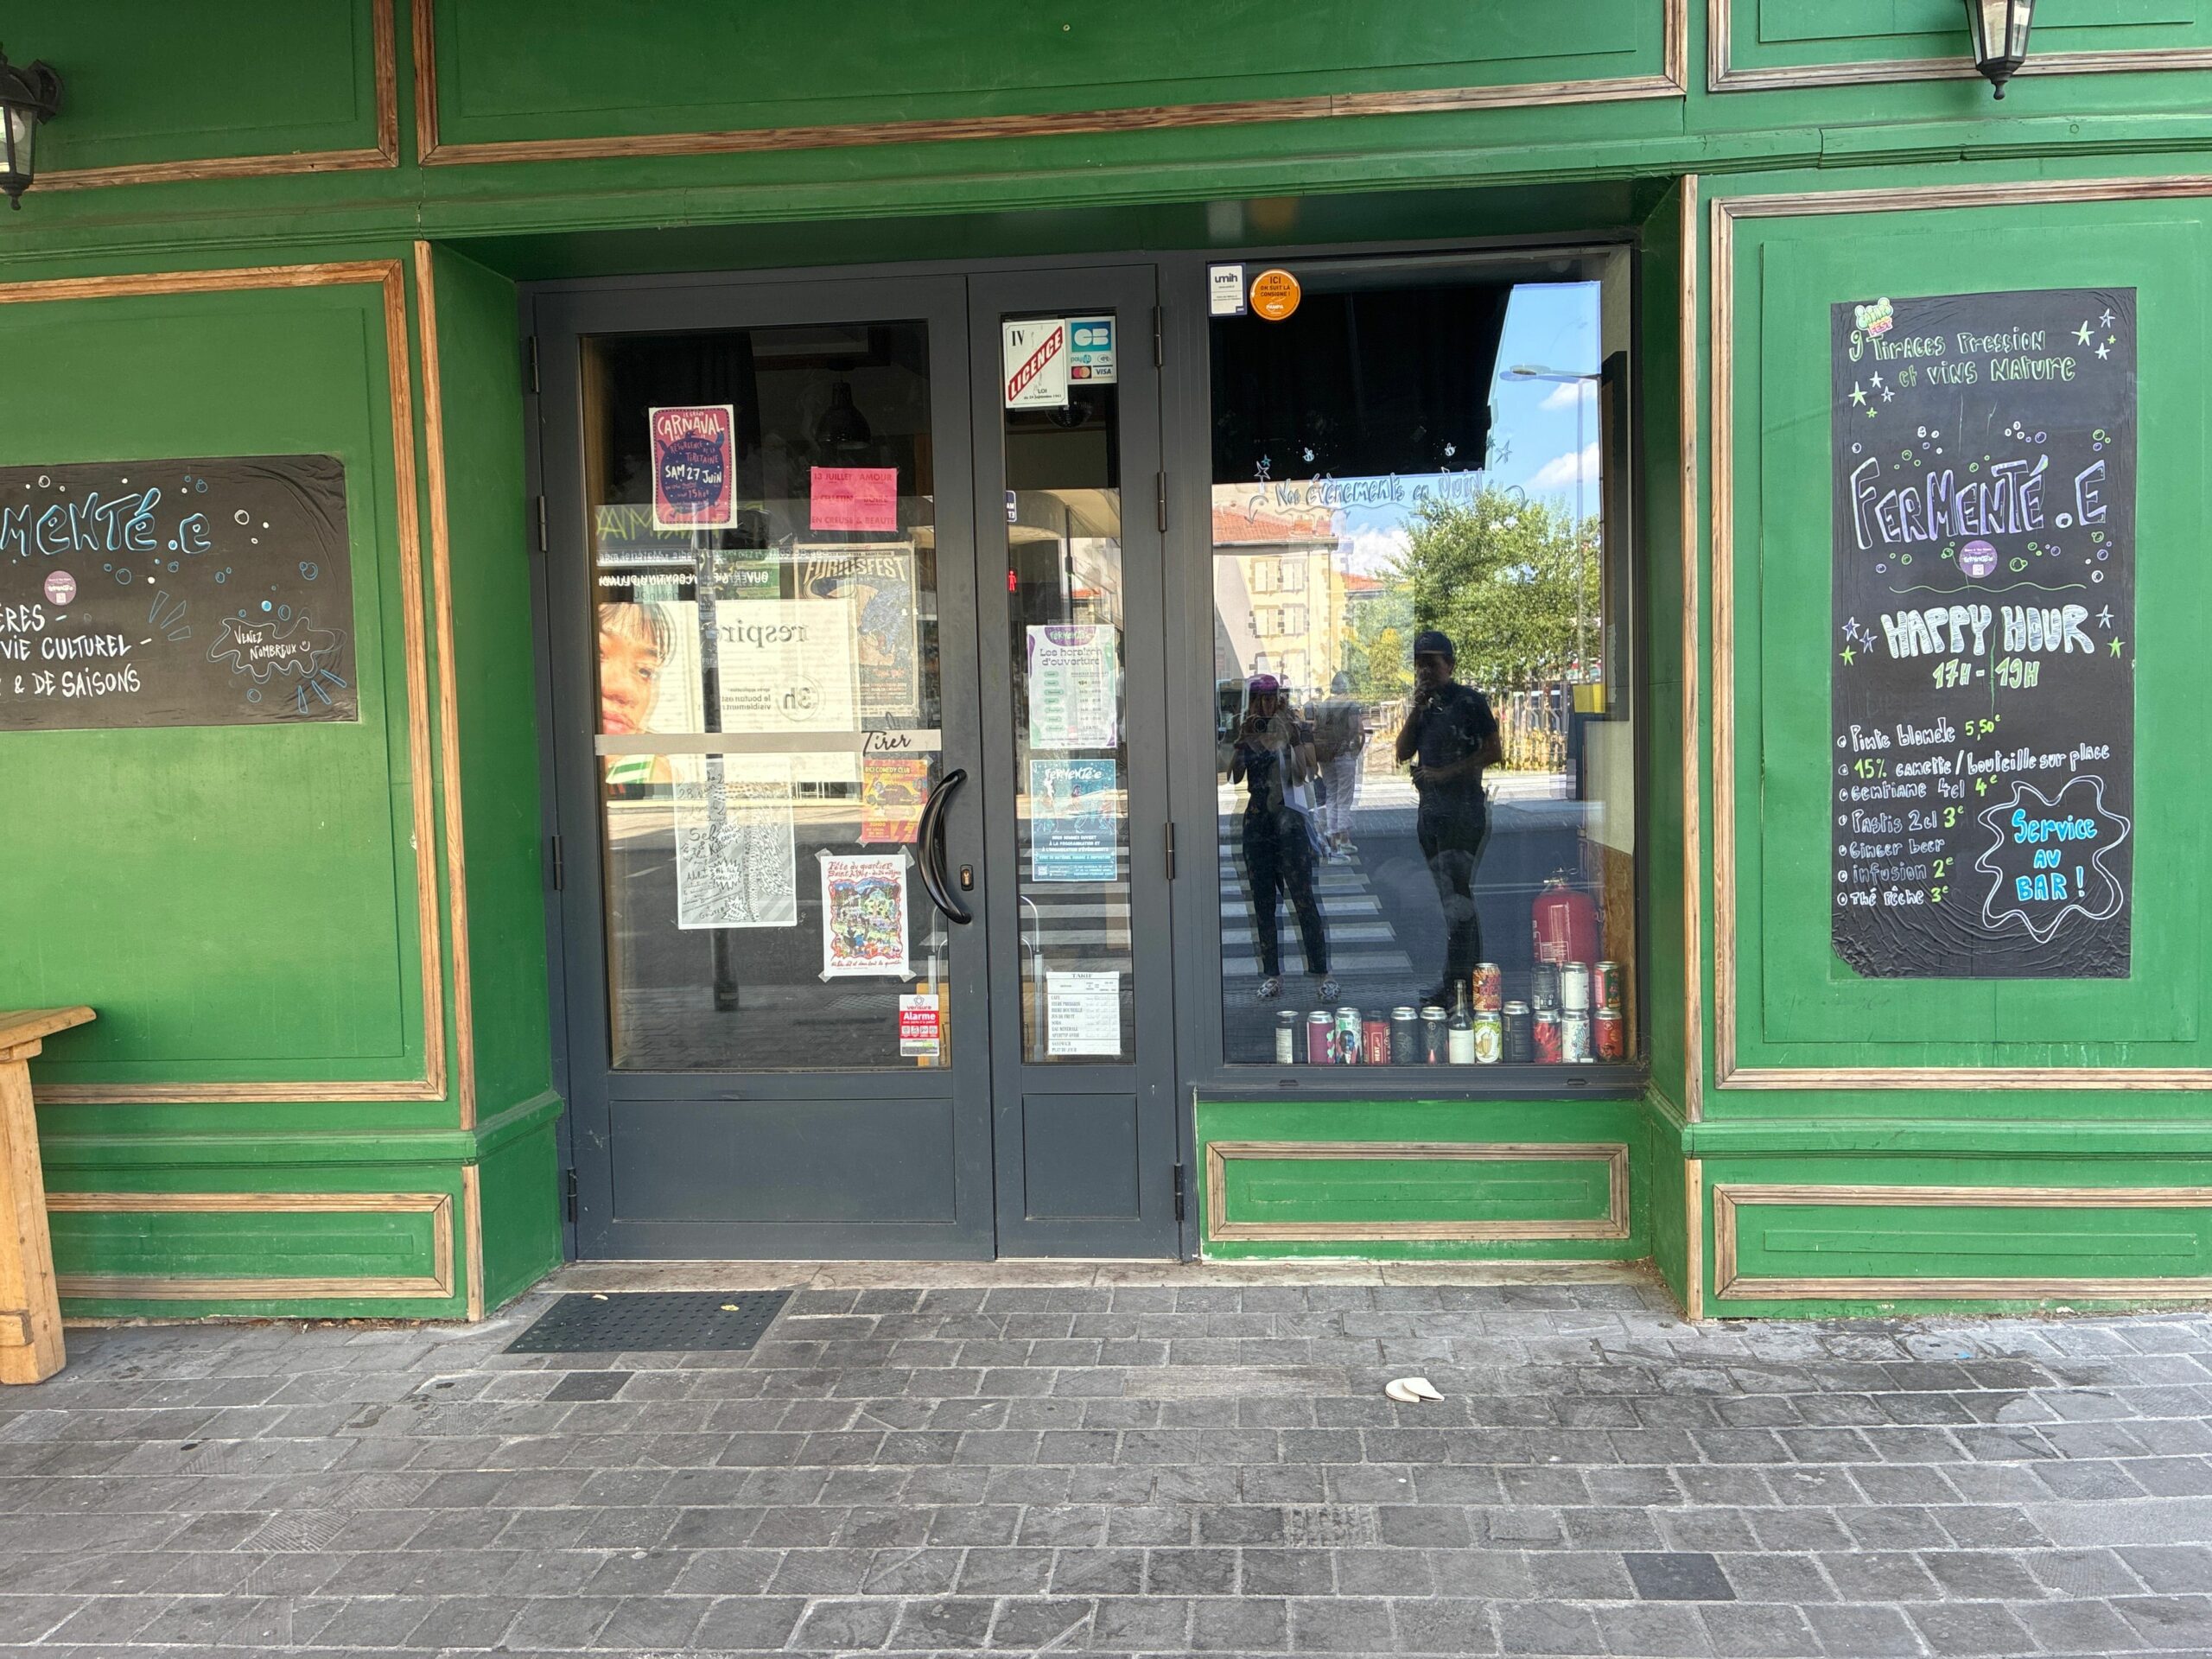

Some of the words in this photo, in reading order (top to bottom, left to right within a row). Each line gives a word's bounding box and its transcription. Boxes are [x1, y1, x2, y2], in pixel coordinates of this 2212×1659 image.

[1215, 273, 1237, 283] umih
[1011, 330, 1025, 346] IV
[1074, 328, 1109, 346] CB
[1849, 330, 1863, 361] 9
[1010, 330, 1063, 396] LICENCE
[1899, 365, 1917, 387] et
[658, 413, 725, 442] CARNAVAL
[664, 464, 685, 480] SAM
[687, 467, 700, 480] 27
[859, 473, 892, 481] AMOUR
[1275, 479, 1300, 506] Nos
[1413, 484, 1429, 500] en
[804, 556, 906, 584] FURIOSFEST
[234, 625, 263, 645] VENEZ
[1880, 604, 1992, 658] HAPPY
[2000, 604, 2094, 654] HOUR
[41, 634, 132, 660] CULTUREL
[250, 644, 297, 661] NOMBREUX
[1039, 648, 1058, 657] Les
[14, 675, 25, 694] &
[32, 671, 56, 696] DE
[1932, 658, 1971, 689] 17H
[1994, 657, 2040, 689] 19H
[861, 730, 912, 757] Tirer
[1850, 725, 1891, 752] Pinte
[1897, 717, 1955, 747] blonde
[1854, 759, 1887, 779] 15%
[1967, 747, 2037, 775] bouteille
[2039, 753, 2066, 769] sur
[2069, 742, 2110, 772] place
[1851, 781, 1927, 801] Gentiane
[1938, 778, 1965, 799] 4cl
[1852, 809, 1903, 834] Pastis
[1908, 810, 1937, 831] 2cl
[2012, 808, 2098, 843] Service
[1849, 841, 1903, 859] Ginger
[1909, 838, 1945, 854] beer
[2033, 849, 2062, 869] AU
[830, 861, 848, 870] Fête
[1853, 861, 1927, 885] infusion
[1850, 887, 1877, 906] Thé
[1884, 886, 1924, 906] Pêche
[2015, 873, 2069, 901] BAR
[903, 1011, 936, 1020] Alarme
